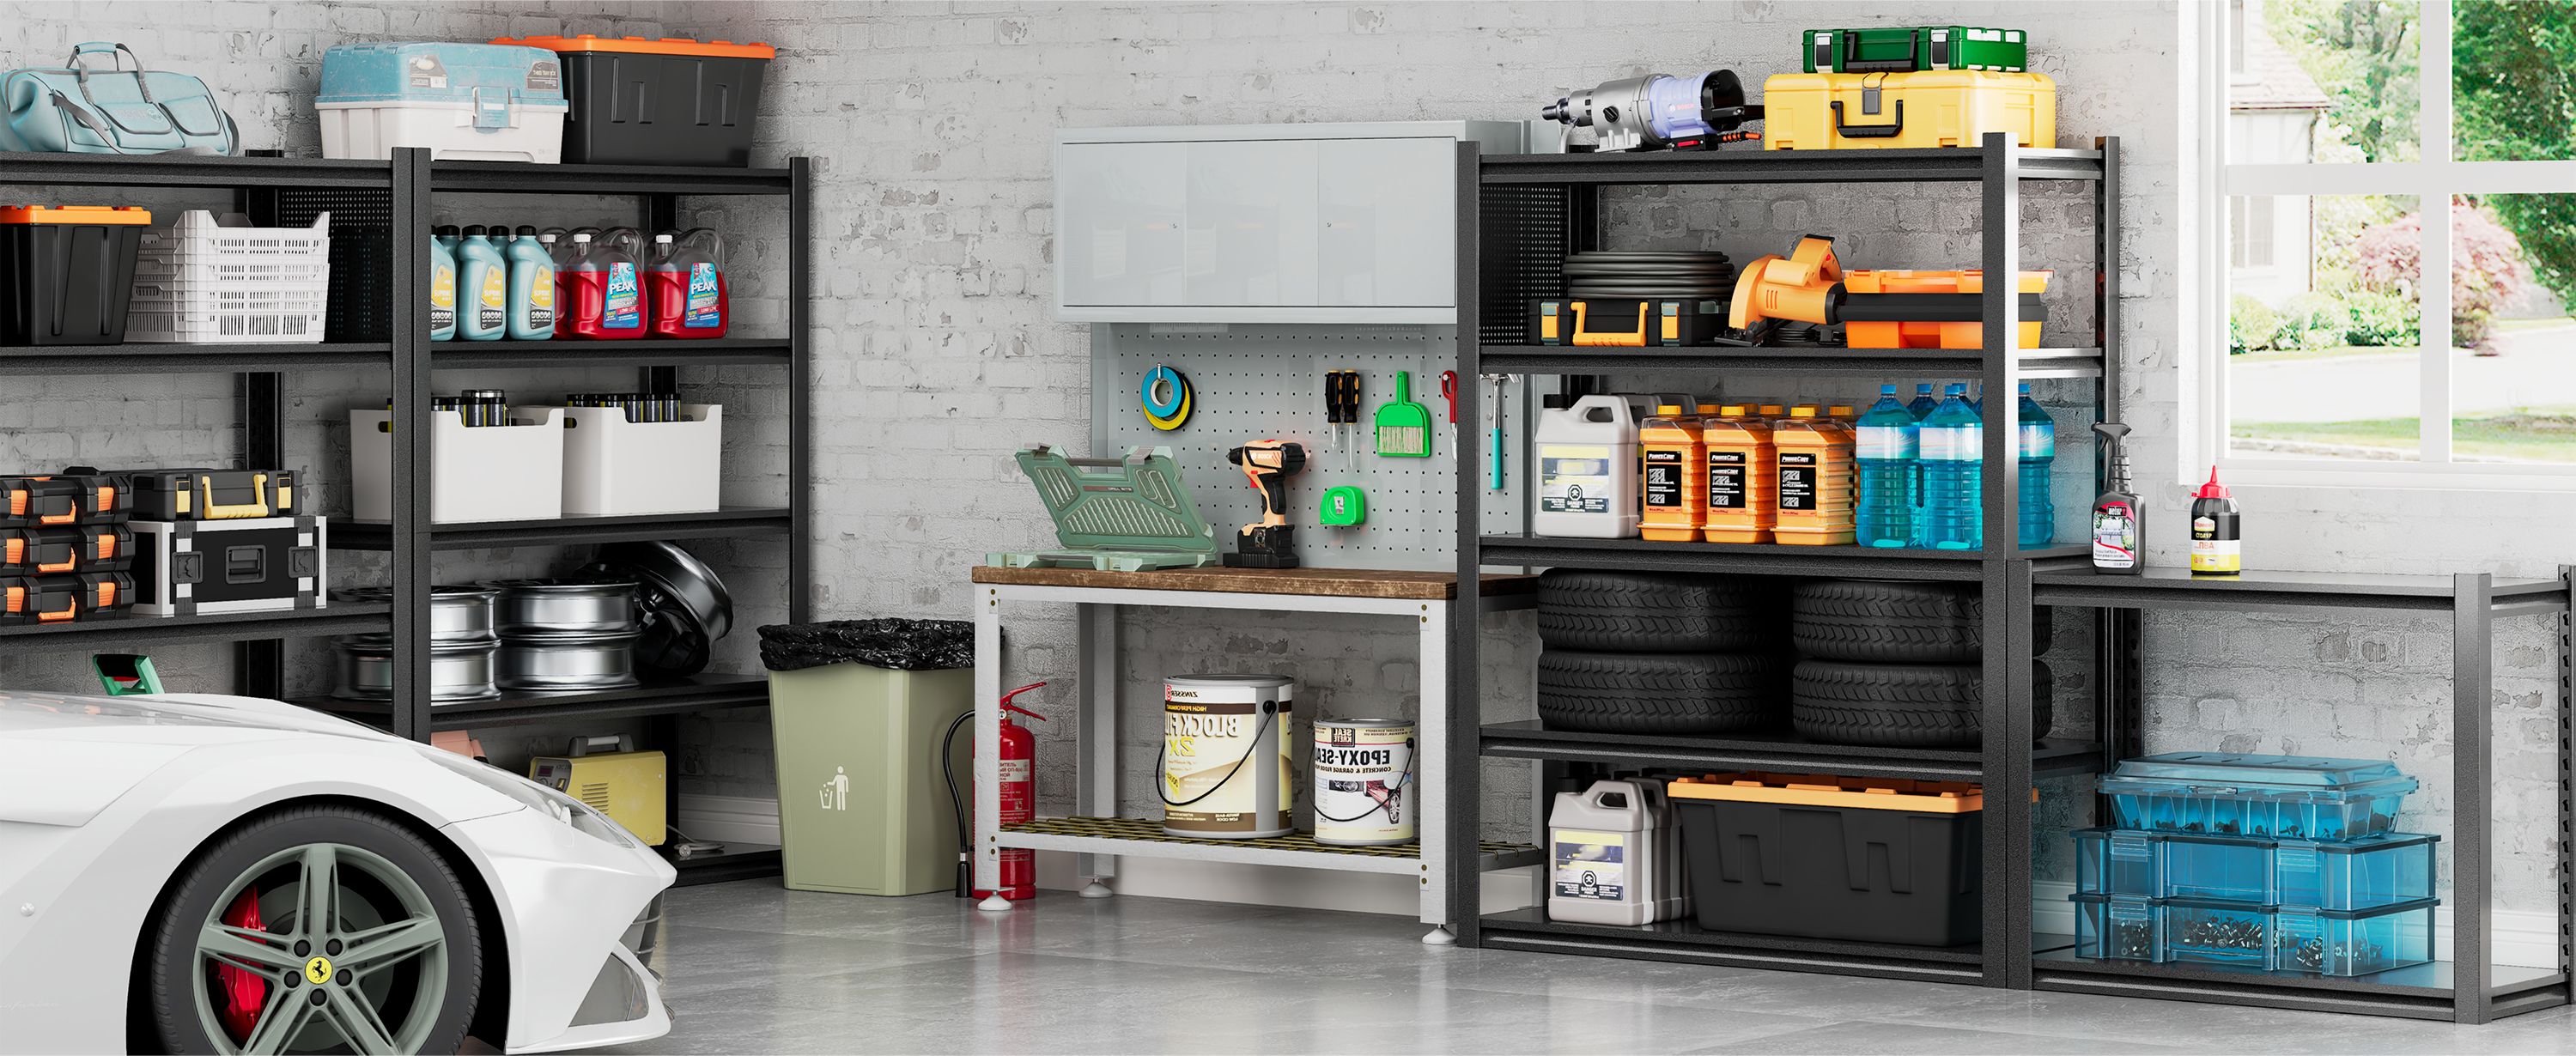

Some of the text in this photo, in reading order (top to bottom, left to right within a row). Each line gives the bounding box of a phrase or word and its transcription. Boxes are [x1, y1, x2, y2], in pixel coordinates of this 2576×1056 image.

[112, 108, 149, 120] BOSCH
[610, 279, 636, 295] PEAK
[691, 279, 717, 295] PEAK
[2198, 541, 2215, 549] ПВА
